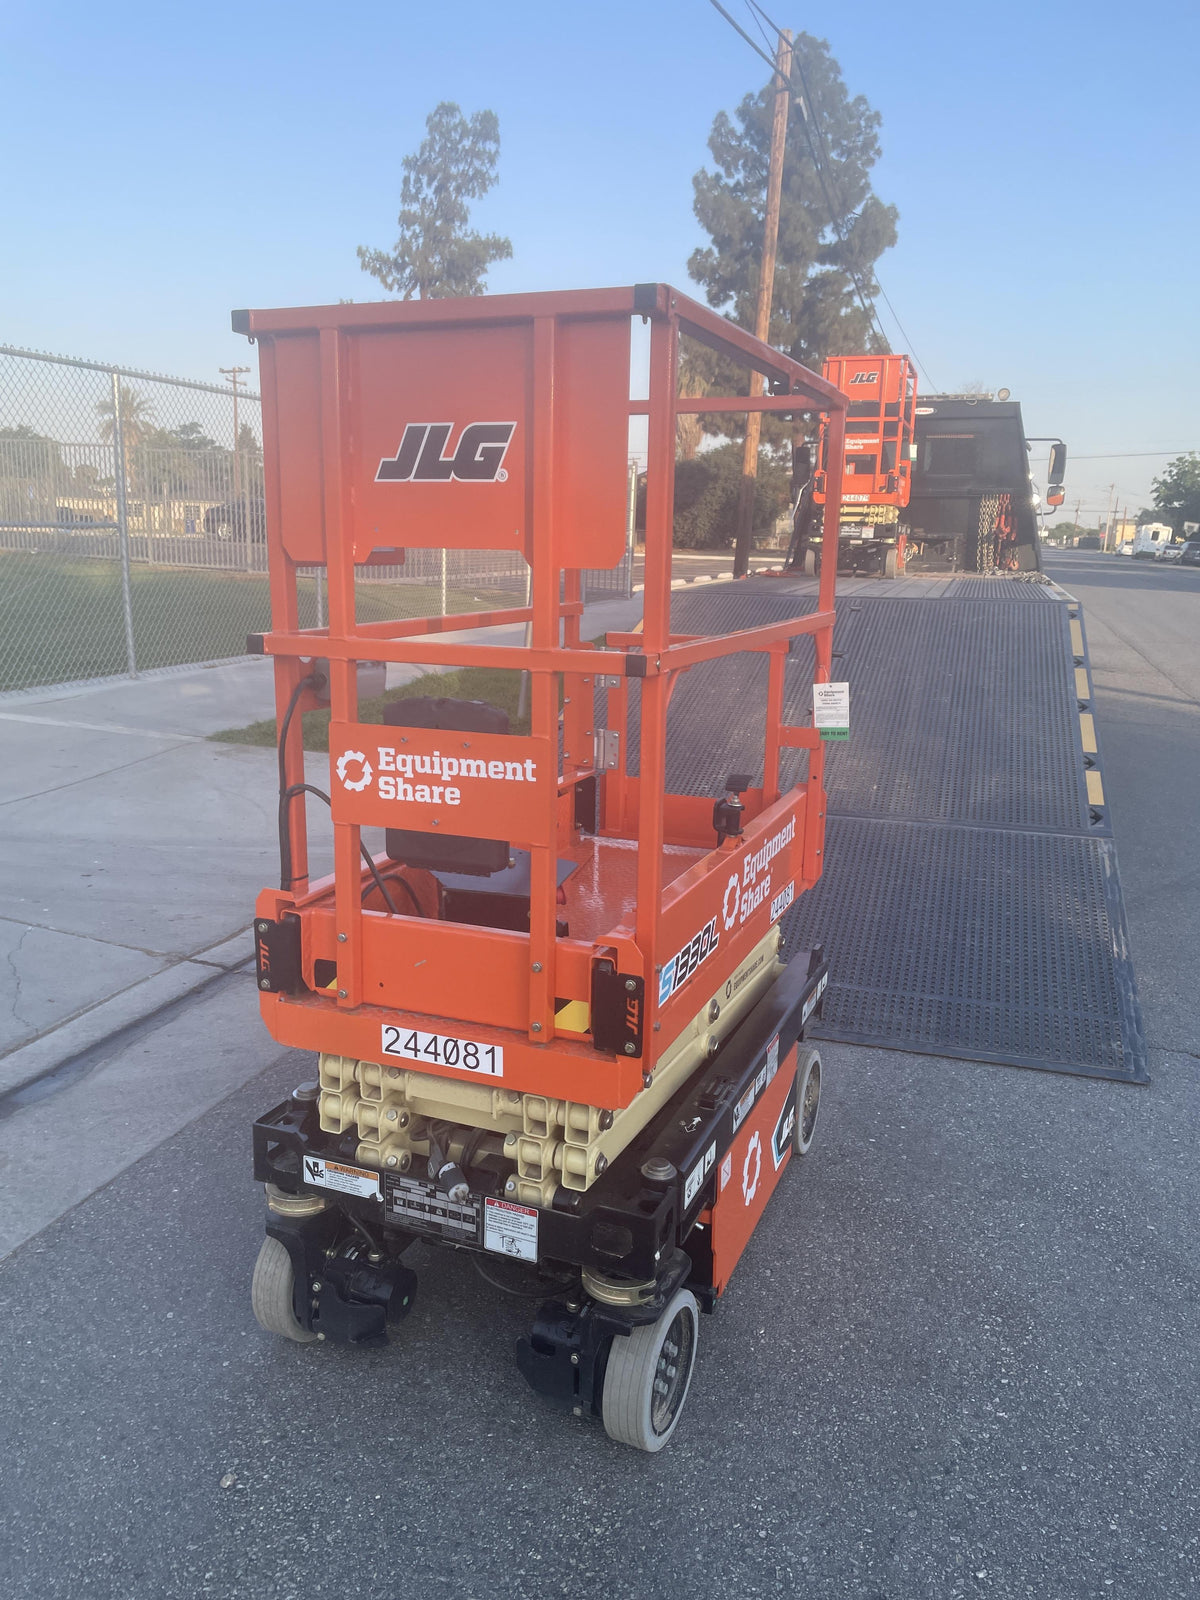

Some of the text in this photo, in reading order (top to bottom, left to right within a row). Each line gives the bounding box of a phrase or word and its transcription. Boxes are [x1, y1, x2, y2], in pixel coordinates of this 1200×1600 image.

[849, 371, 879, 384] JLG
[374, 421, 517, 482] JLG
[377, 747, 537, 782] Equipment
[378, 776, 461, 805] Share
[742, 813, 796, 887] Equipment
[740, 874, 771, 924] Share
[259, 938, 270, 971] JLG
[626, 997, 639, 1035] JLG
[384, 1026, 496, 1074] 244081
[501, 1203, 530, 1215] DANGER
